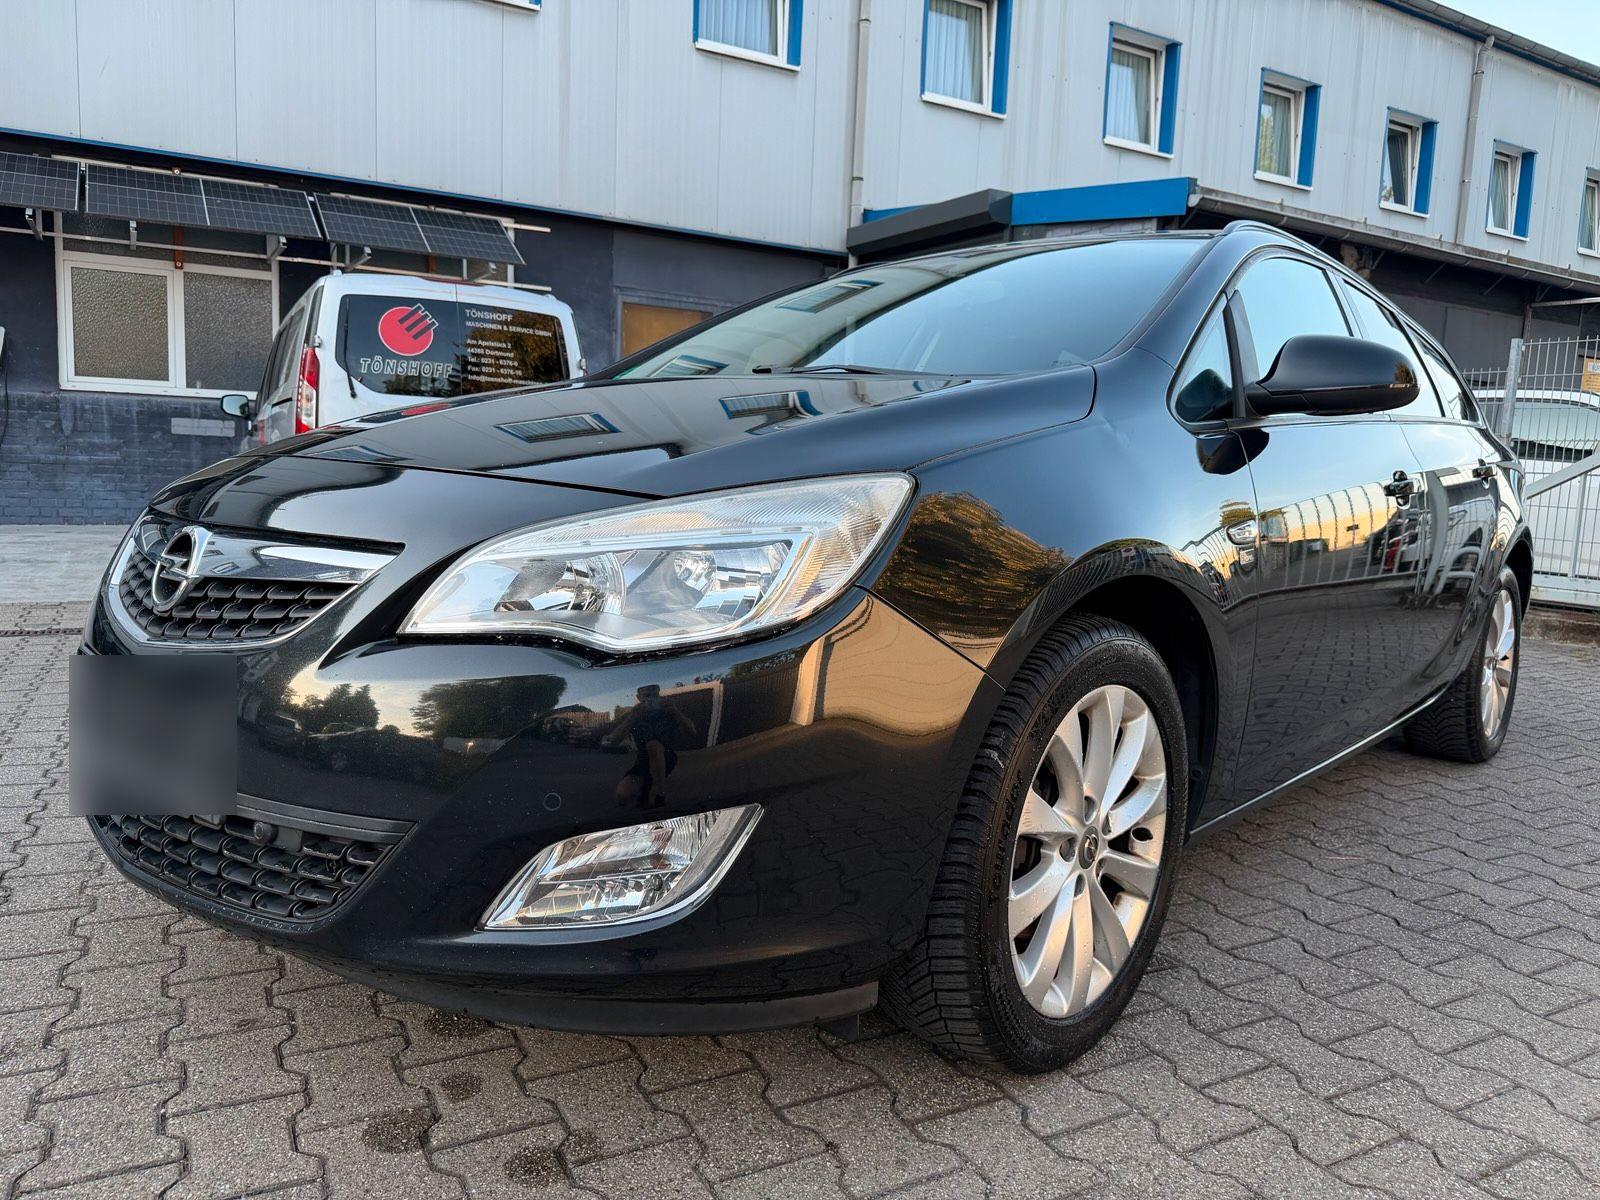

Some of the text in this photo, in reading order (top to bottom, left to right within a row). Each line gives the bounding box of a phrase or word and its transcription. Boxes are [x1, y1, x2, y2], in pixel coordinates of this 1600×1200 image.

[465, 308, 513, 321] TÖNSHOFF
[465, 321, 502, 330] MASCHINEN
[509, 326, 534, 334] SERVICE
[485, 349, 515, 358] Dortmund
[360, 355, 453, 379] TÖNSHOFF
